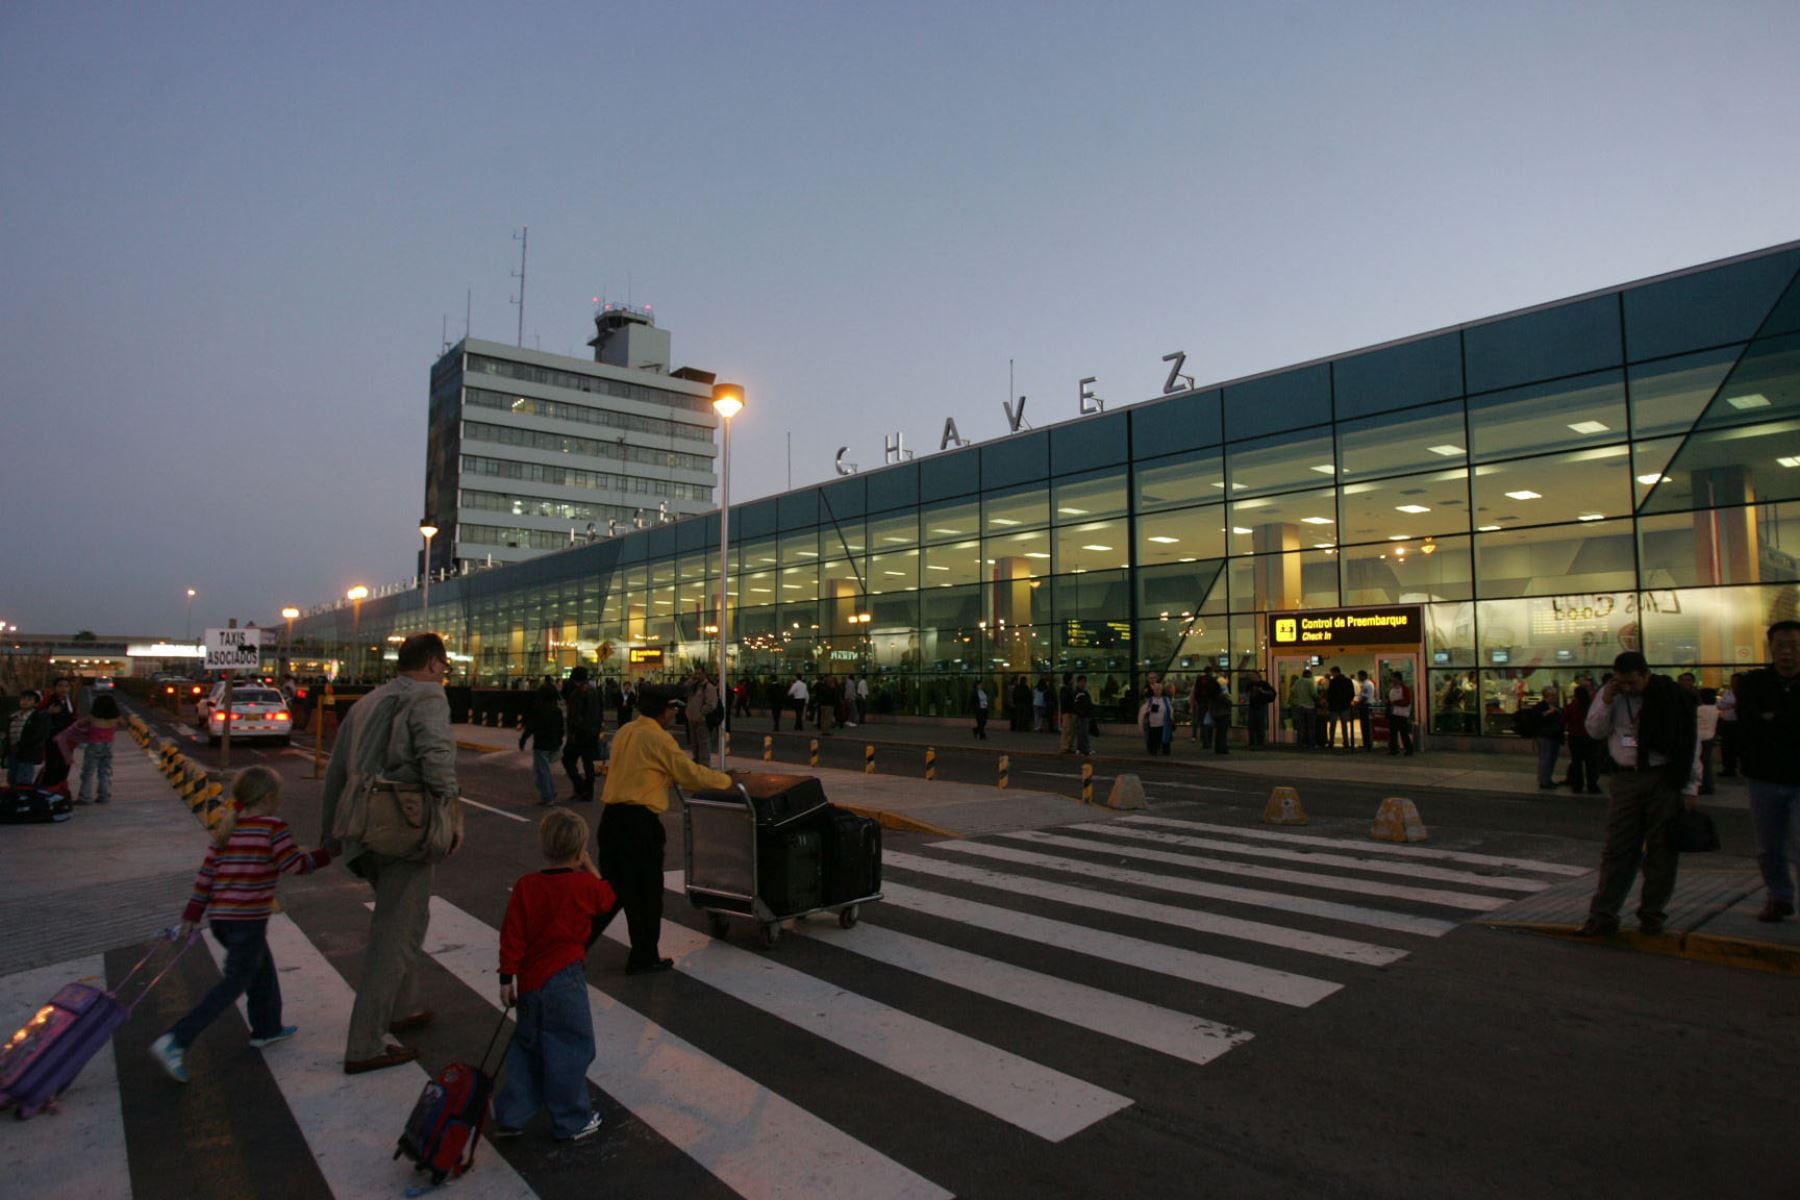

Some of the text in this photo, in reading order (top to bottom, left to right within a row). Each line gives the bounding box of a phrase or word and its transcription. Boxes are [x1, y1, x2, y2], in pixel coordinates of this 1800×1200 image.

[835, 350, 1187, 476] CHAVEZ
[1301, 614, 1408, 629] Control de Preembarque
[219, 631, 246, 646] TAXIS
[1302, 631, 1324, 641] Check
[207, 650, 258, 666] ASOCIADOS
